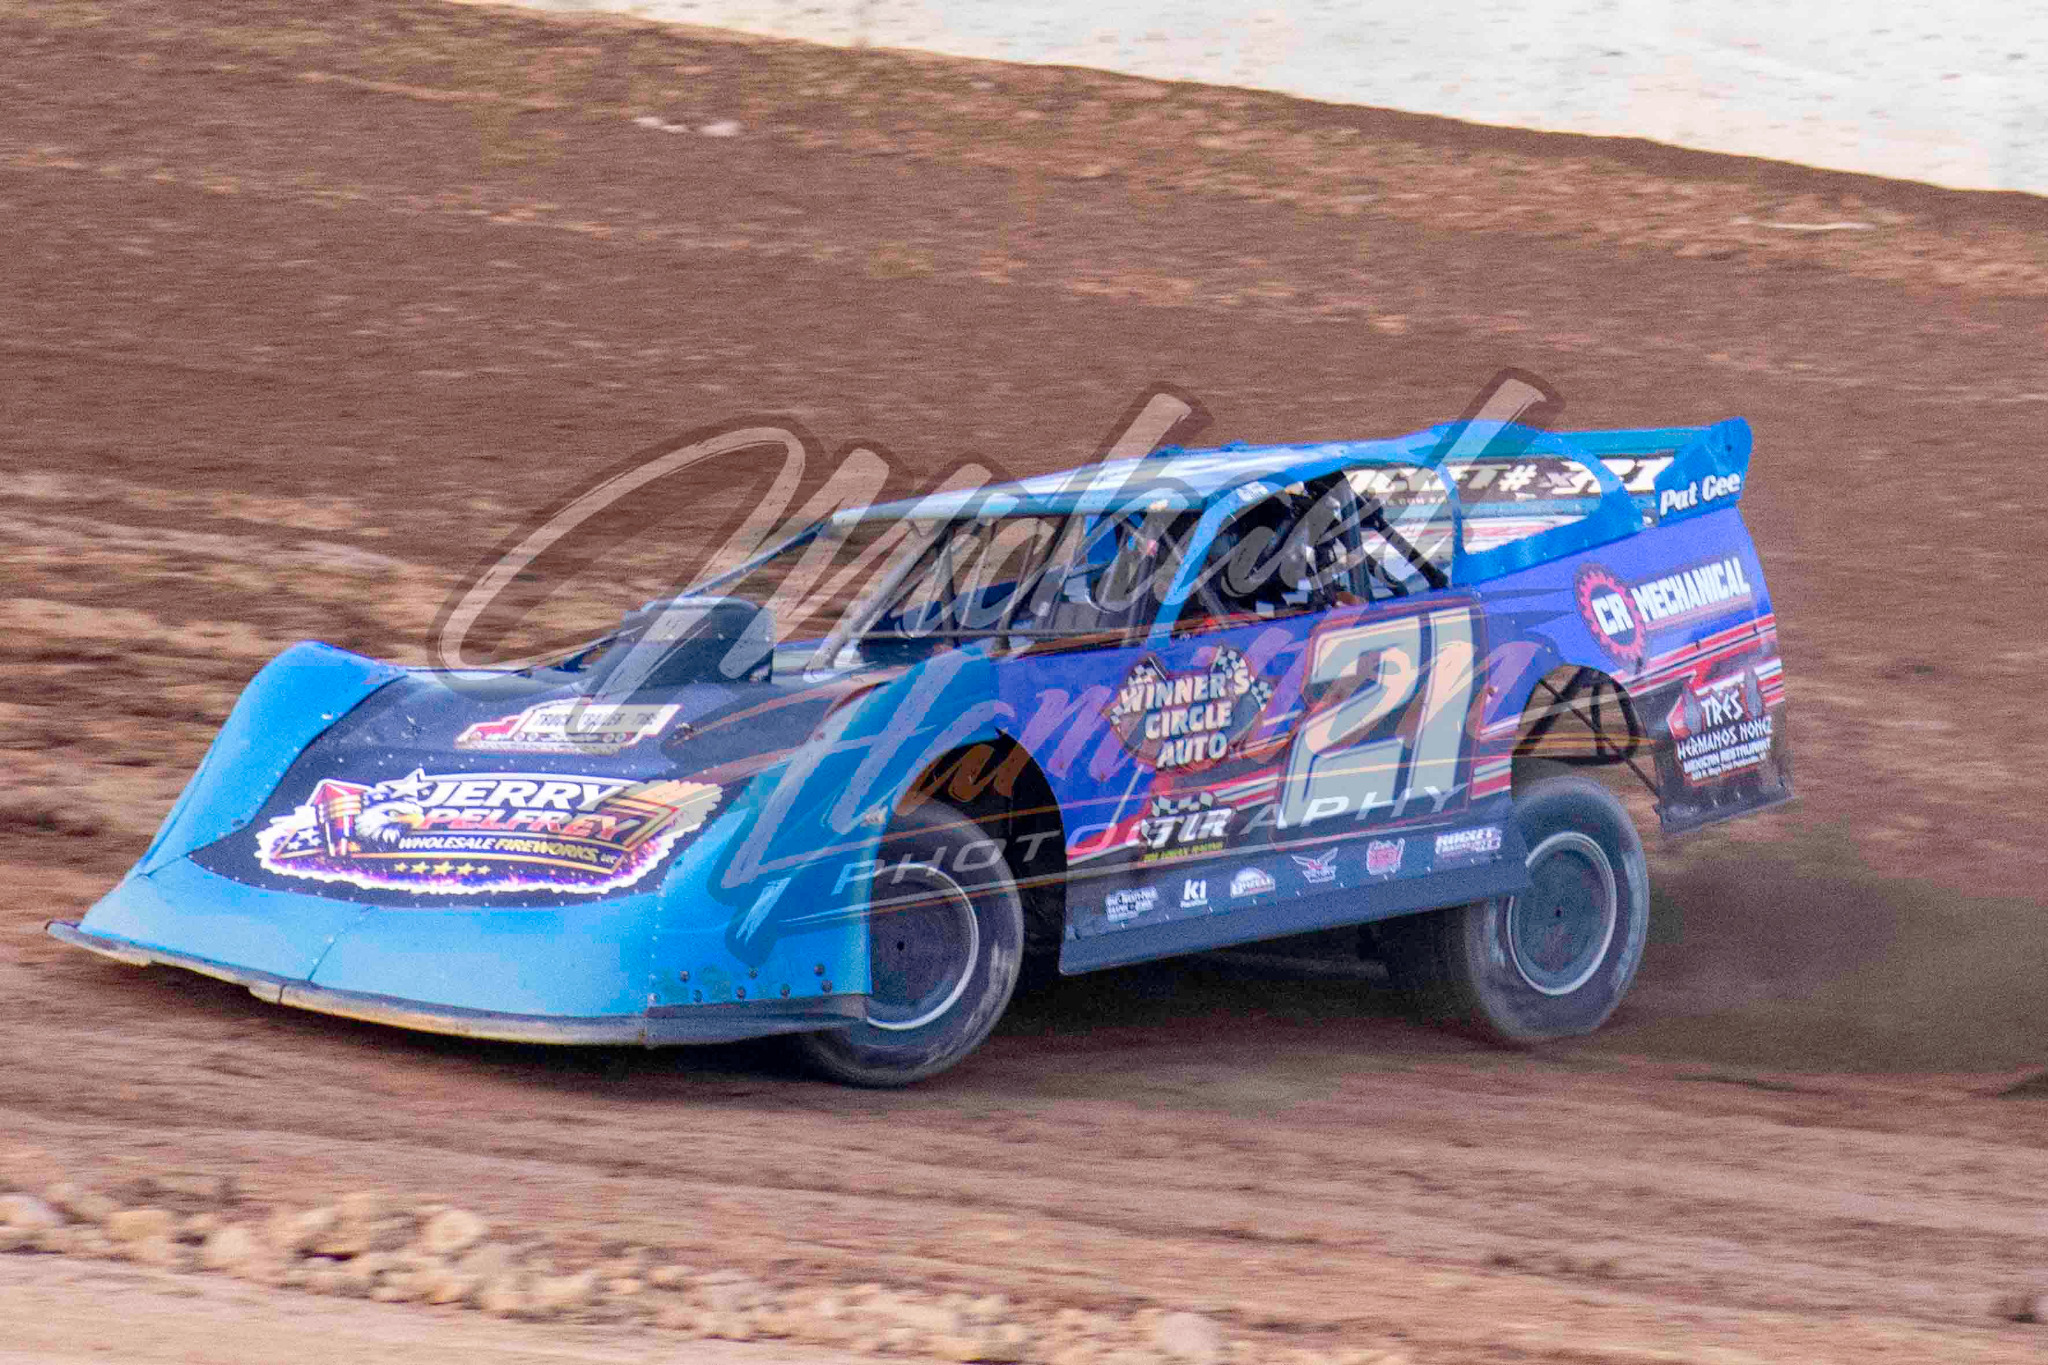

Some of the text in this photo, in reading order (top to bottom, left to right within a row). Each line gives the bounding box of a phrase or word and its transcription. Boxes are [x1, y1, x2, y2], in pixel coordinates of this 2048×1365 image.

[1659, 471, 1743, 517] Pat Gee
[1591, 556, 1752, 636] CR MECHANICAL
[1119, 667, 1251, 714] WINNER'S
[1700, 688, 1744, 728] TRES
[1145, 700, 1233, 739] CIRCLE
[1277, 604, 1477, 829] 21
[1156, 731, 1229, 769] AUTO
[417, 779, 629, 812] JERRY
[418, 807, 641, 842] PELFREY
[398, 836, 495, 850] WHOLESALE
[495, 838, 600, 863] FIREWORKS
